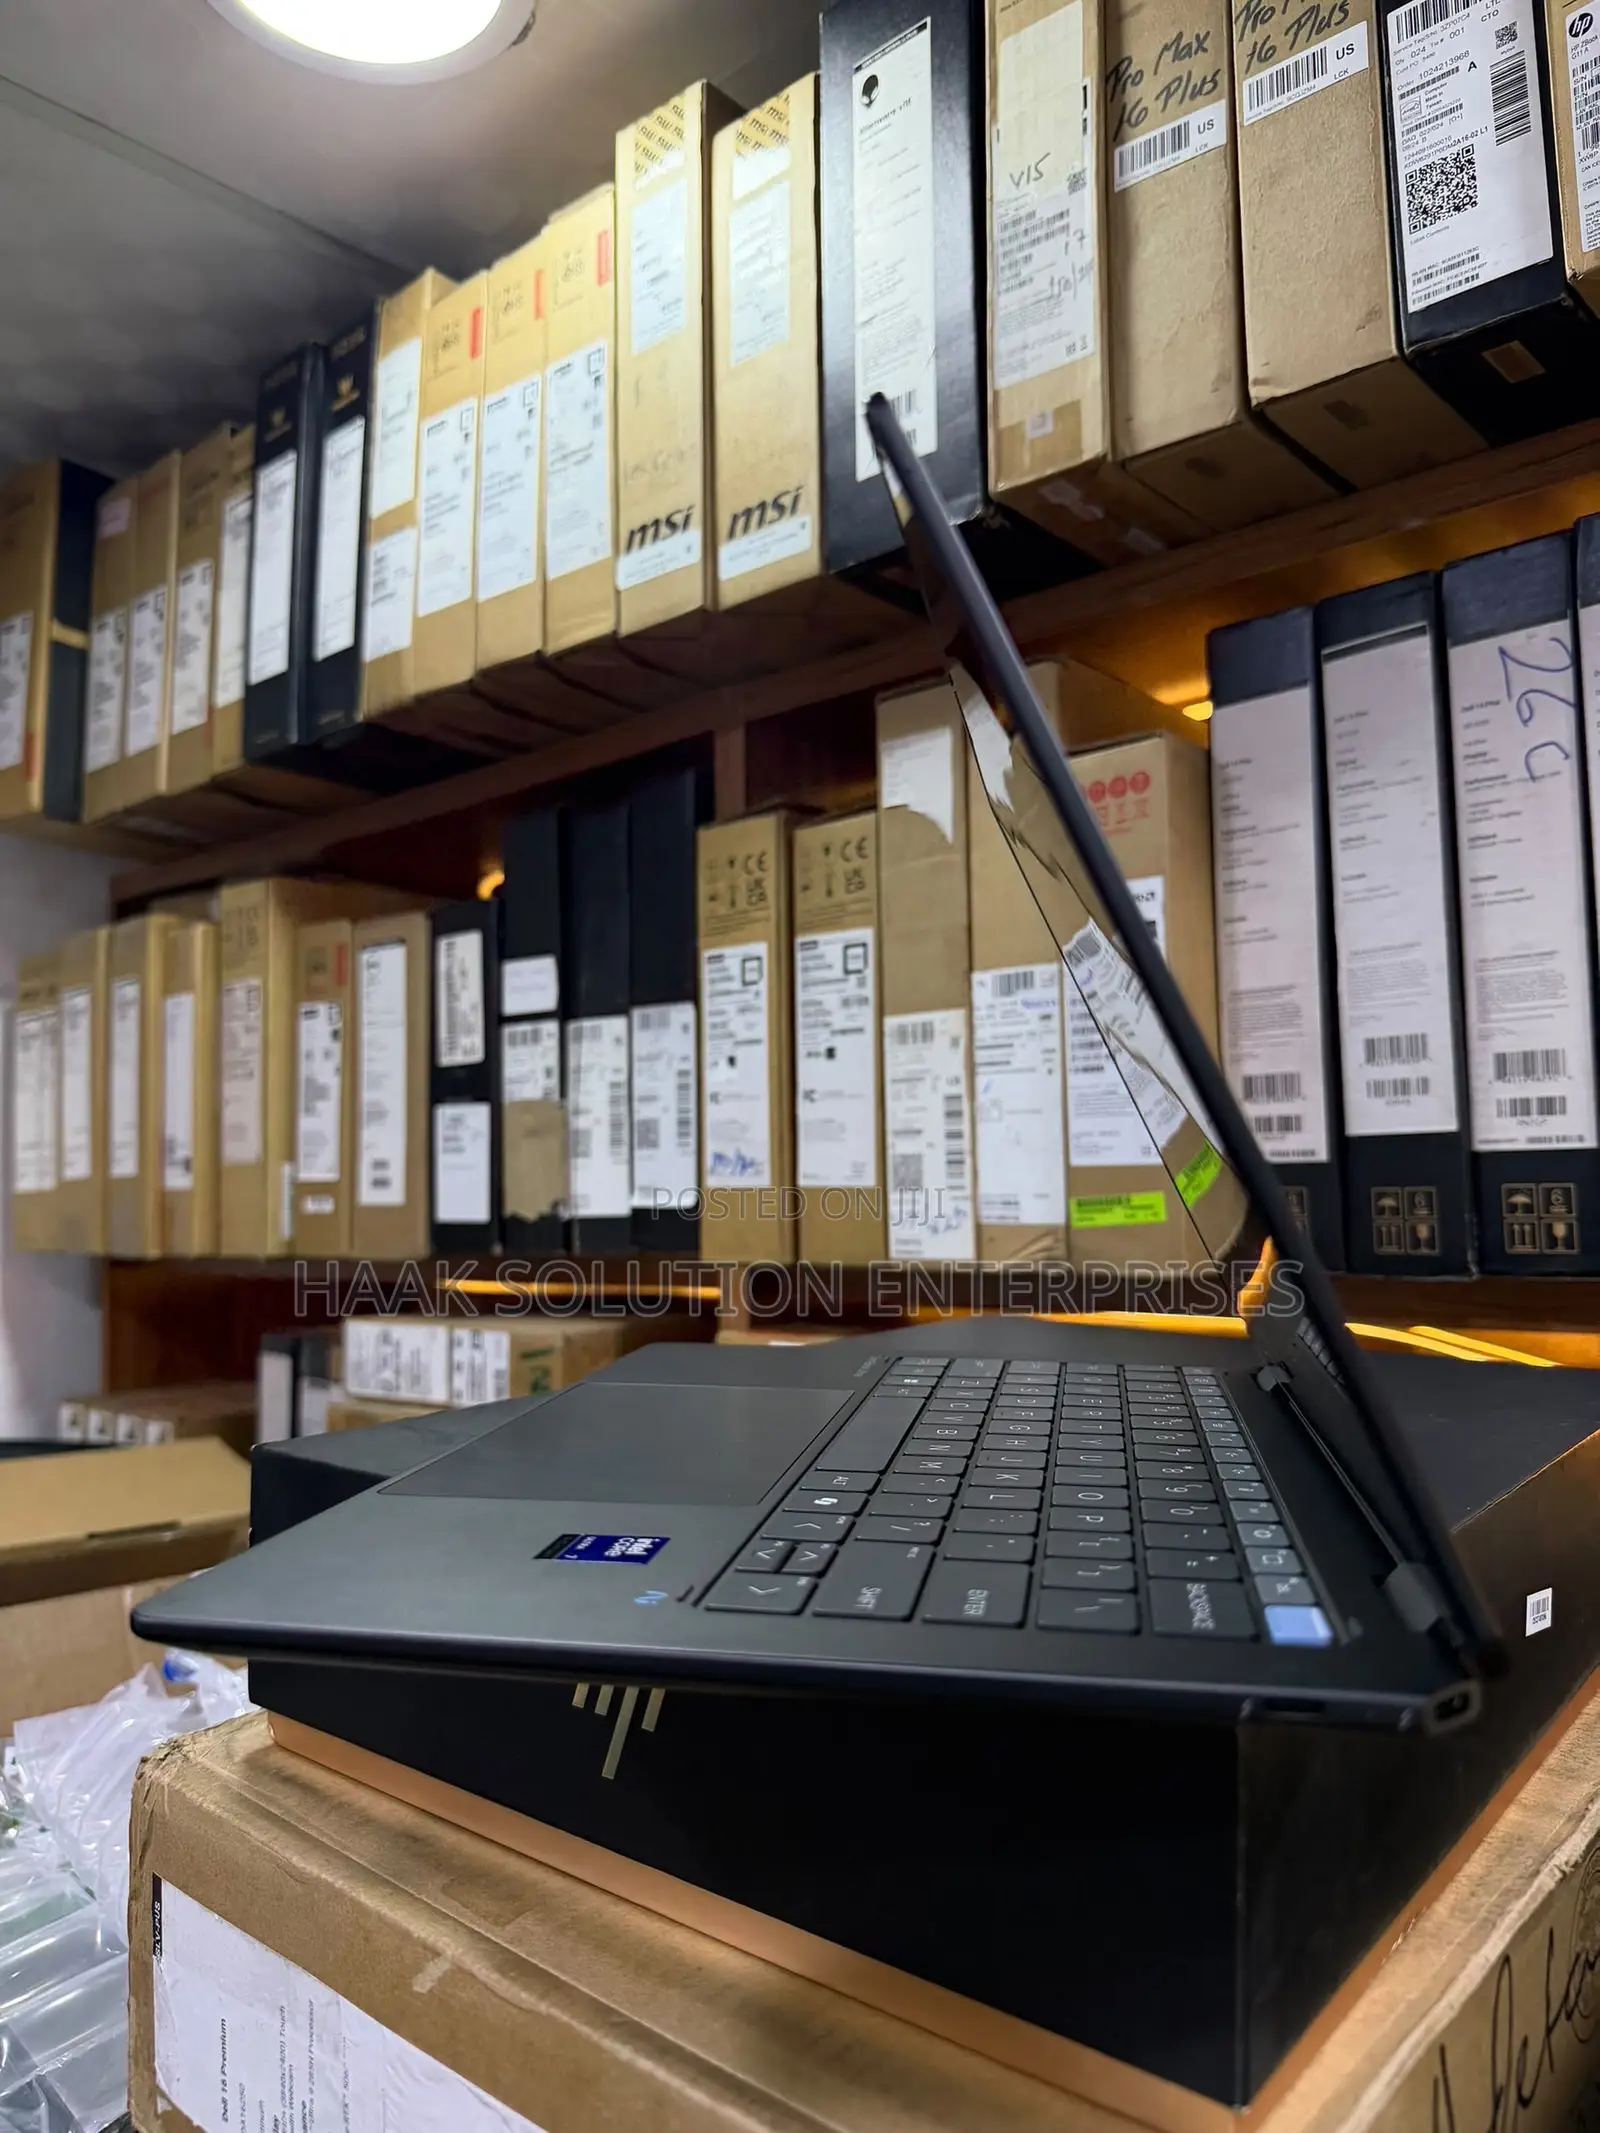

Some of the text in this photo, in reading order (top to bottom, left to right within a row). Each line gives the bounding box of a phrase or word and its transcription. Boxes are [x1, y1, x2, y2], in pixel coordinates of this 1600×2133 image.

[1481, 10, 1499, 22] CTO
[1569, 12, 1593, 38] hp
[1154, 31, 1210, 75] Max
[1336, 43, 1354, 60] US
[1410, 46, 1426, 59] 024
[1449, 27, 1465, 39] 001
[1571, 43, 1580, 52] HP
[1334, 68, 1349, 80] LCK
[1468, 61, 1478, 72] A
[1155, 68, 1221, 113] Plus
[1197, 119, 1214, 135] US
[728, 485, 804, 540] msi
[626, 504, 695, 554] msi
[854, 1586, 884, 1610] SHIFT
[278, 2005, 286, 2038] Touch
[220, 2018, 229, 2124] Dell 16 Premium
